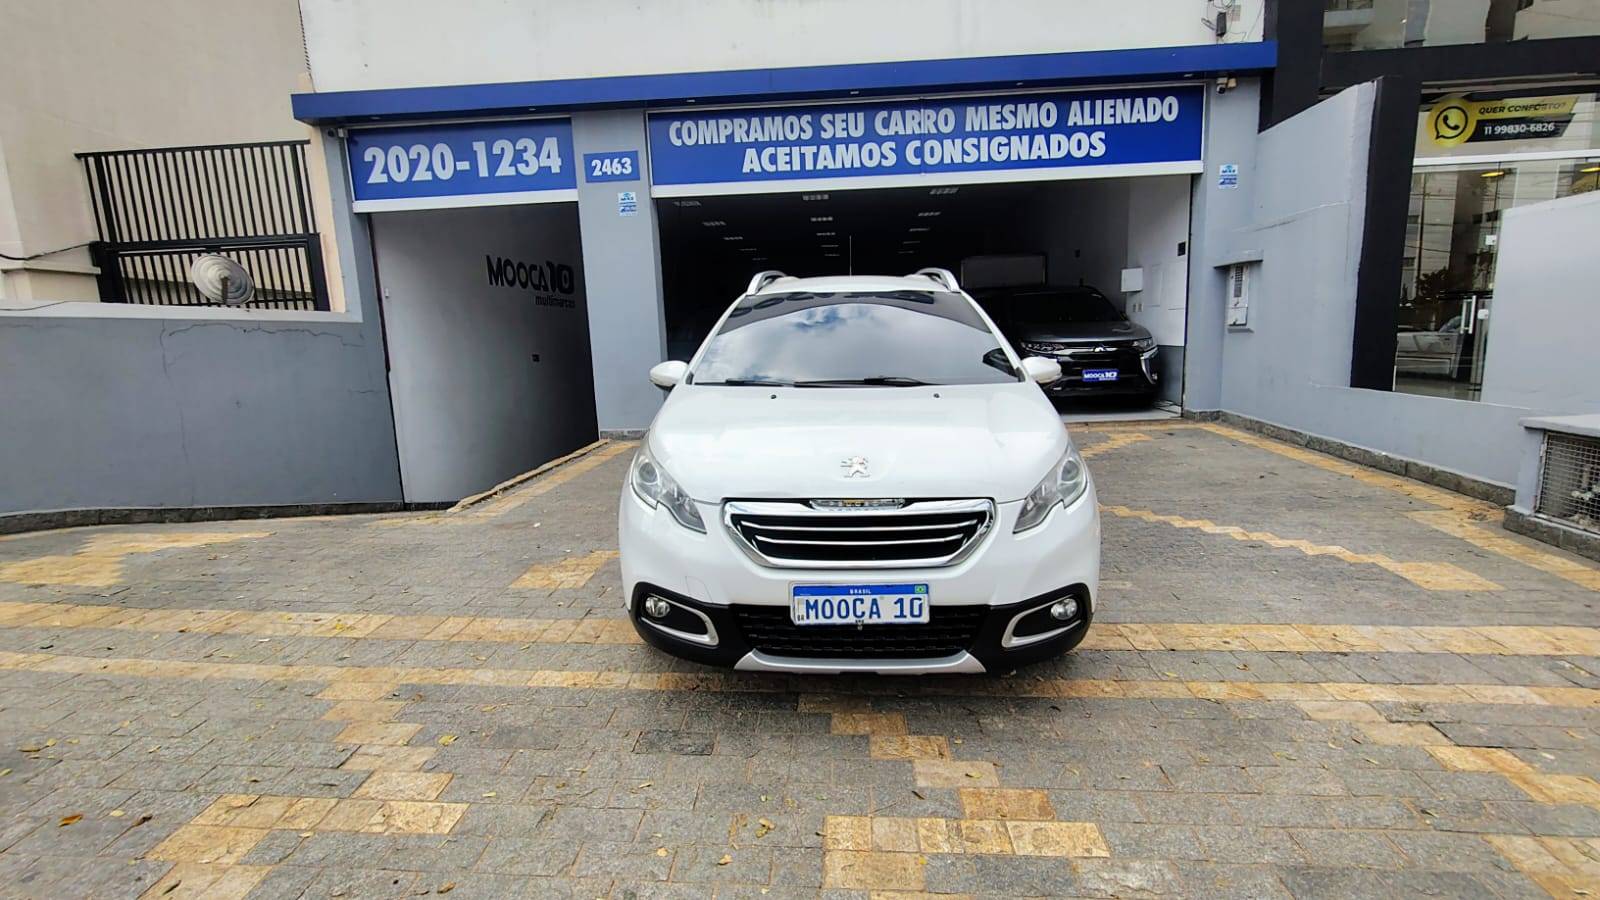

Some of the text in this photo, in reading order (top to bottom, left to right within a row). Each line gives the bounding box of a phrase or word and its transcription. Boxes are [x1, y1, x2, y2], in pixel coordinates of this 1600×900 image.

[669, 95, 1179, 147] COMPRAMOS SEU CARRO MESMO ALIENADO
[1478, 106, 1505, 115] QUER
[1484, 122, 1555, 135] 11 99830-6826
[363, 137, 561, 184] 2020-1234
[742, 131, 1107, 174] ACEITAMOS CONSIGNADOS
[591, 157, 632, 177] 2463
[805, 597, 923, 619] MOOCA 10
